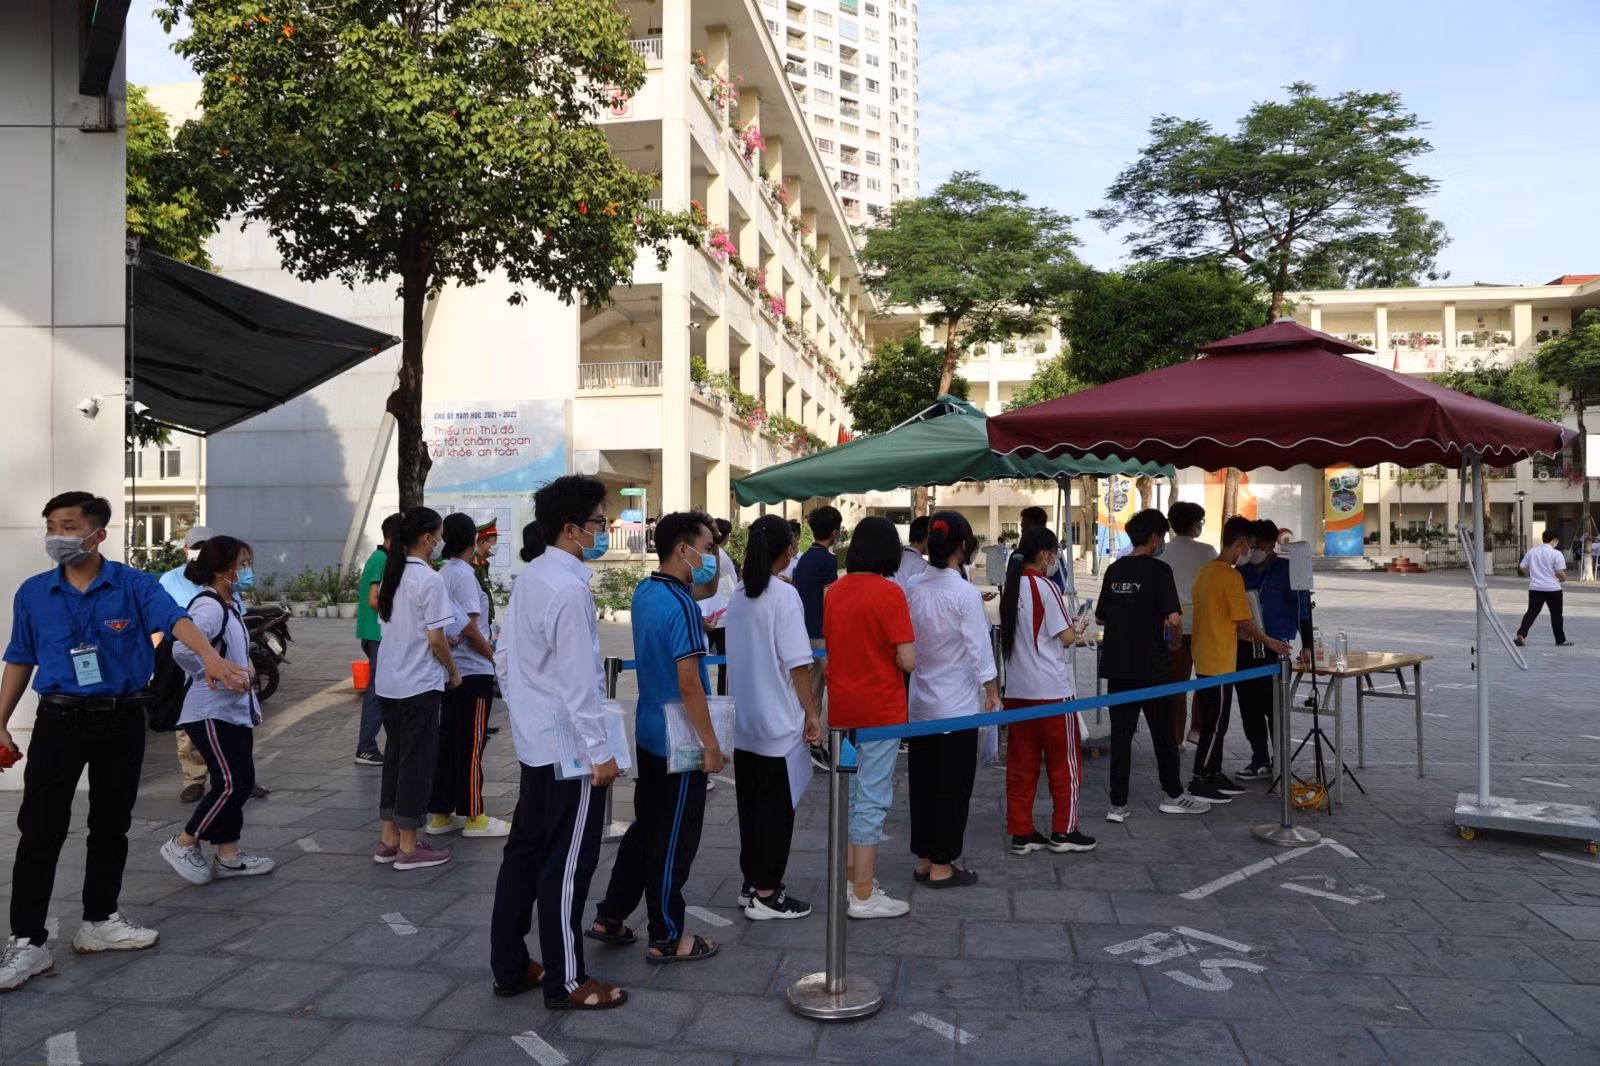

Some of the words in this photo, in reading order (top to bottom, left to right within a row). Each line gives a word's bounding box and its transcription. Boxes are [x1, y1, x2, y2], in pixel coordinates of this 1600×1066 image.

[484, 411, 497, 419] 2021
[434, 426, 460, 435] Thiếu
[462, 427, 477, 435] nhi
[480, 425, 497, 434] Thủ
[500, 425, 514, 434] đô
[444, 435, 460, 446] tốt,
[464, 437, 493, 446] chăm
[496, 437, 530, 447] ngoan
[478, 448, 491, 456] an
[495, 446, 518, 456] toàn
